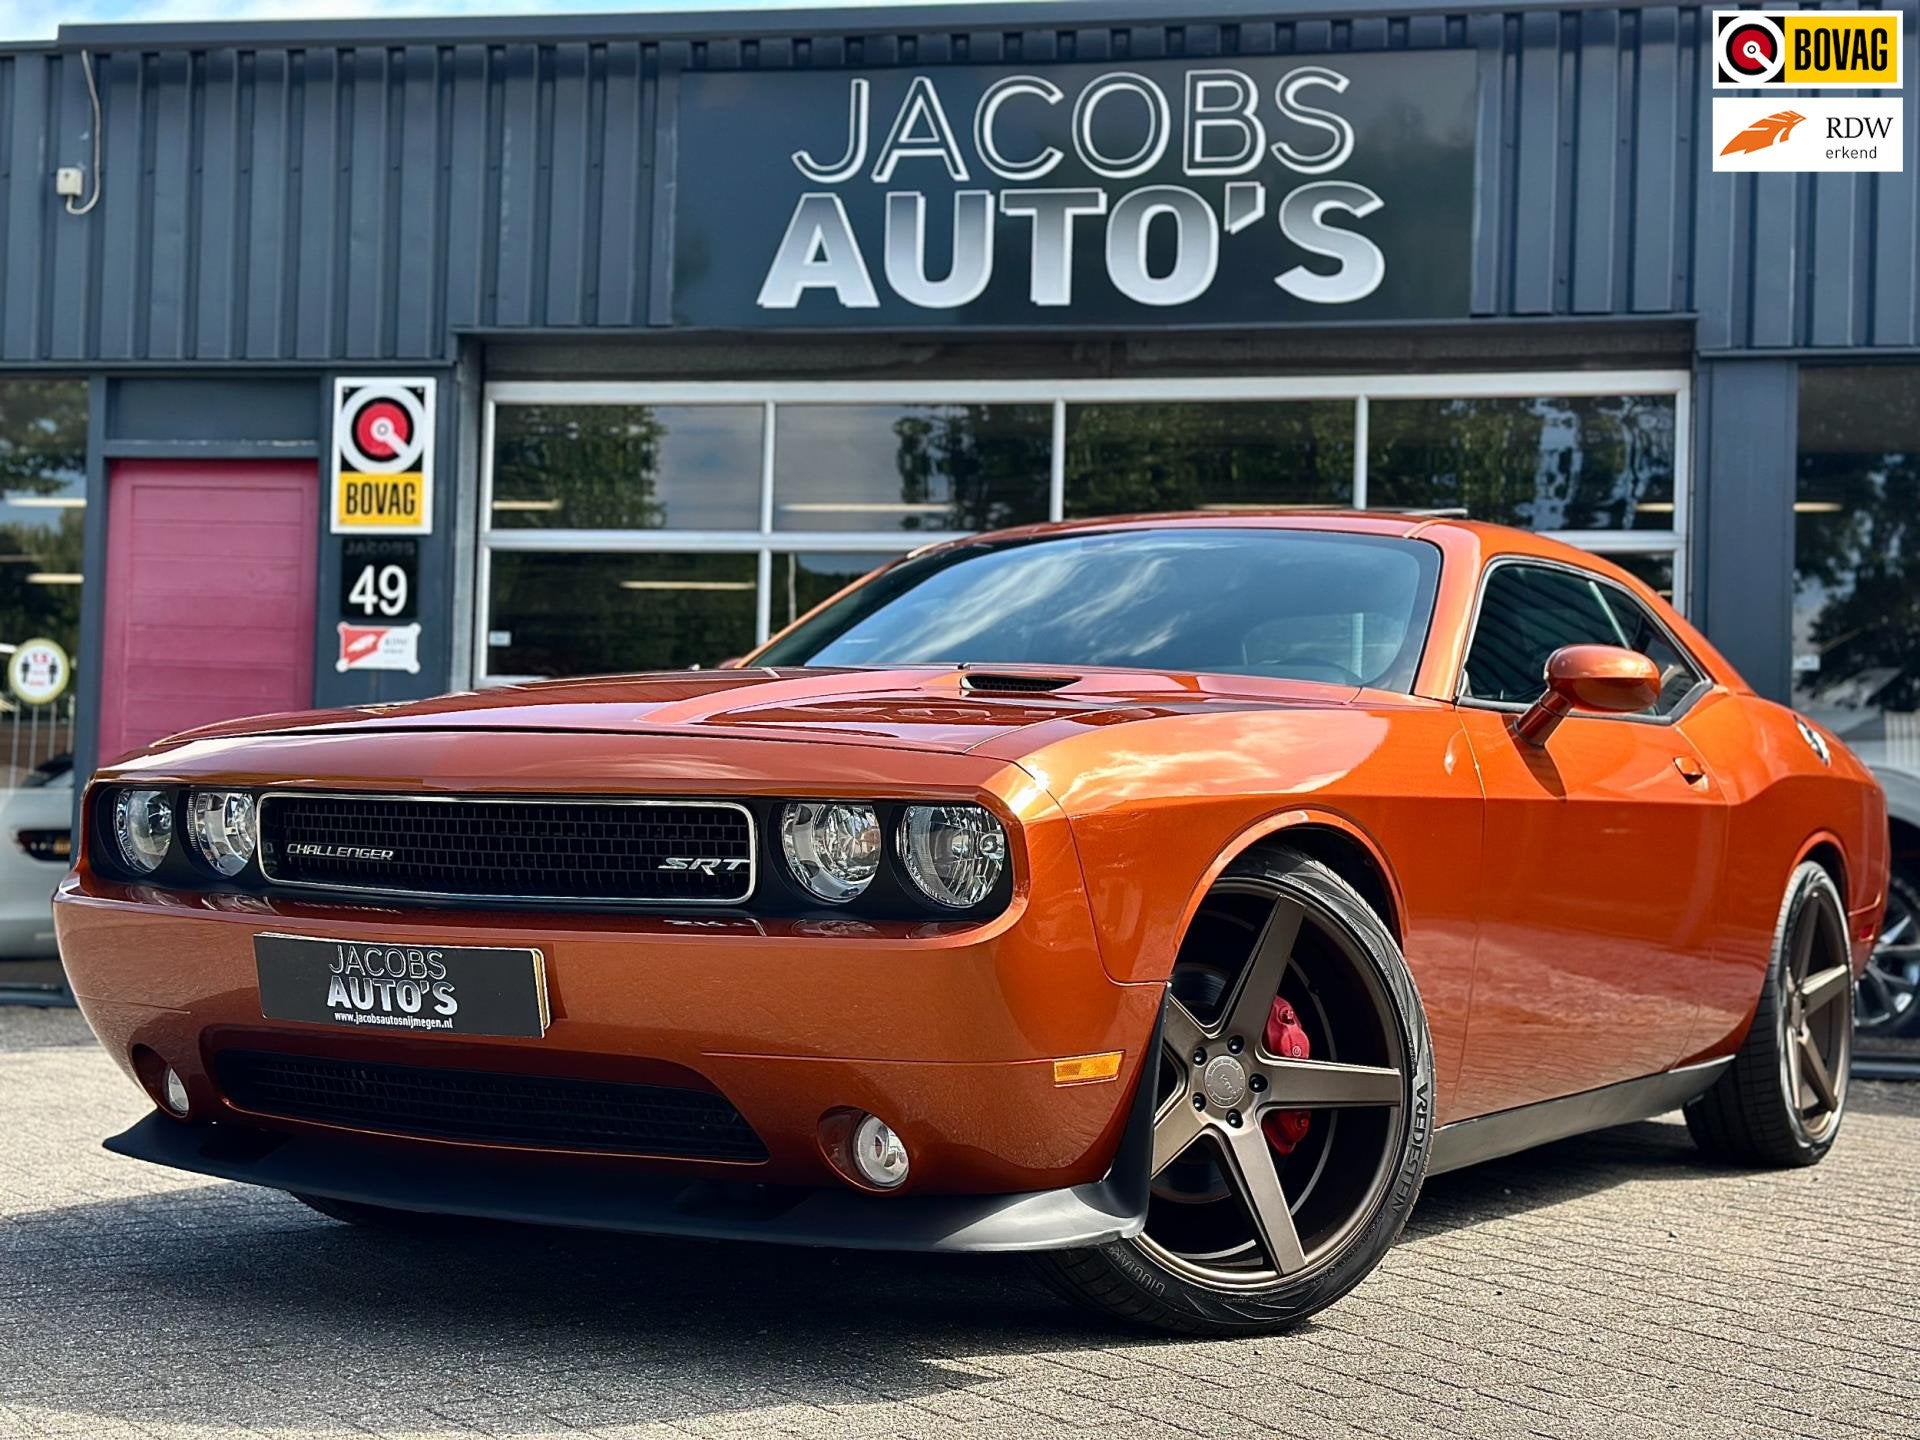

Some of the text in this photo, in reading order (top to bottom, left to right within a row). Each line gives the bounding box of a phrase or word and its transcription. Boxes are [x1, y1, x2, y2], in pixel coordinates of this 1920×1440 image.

[792, 66, 1355, 183] JACOBS
[757, 181, 1386, 308] AUTO'S
[345, 481, 416, 516] BOVAG
[348, 564, 408, 616] 49
[286, 843, 394, 861] CHALLENGER
[657, 857, 751, 876] SRT
[328, 944, 447, 981] JACOBS
[326, 975, 458, 1016] AUTO'S
[334, 1010, 453, 1030] www.jacobsautosnijmegen.nl
[1392, 1082, 1429, 1215] VREDESTEIN
